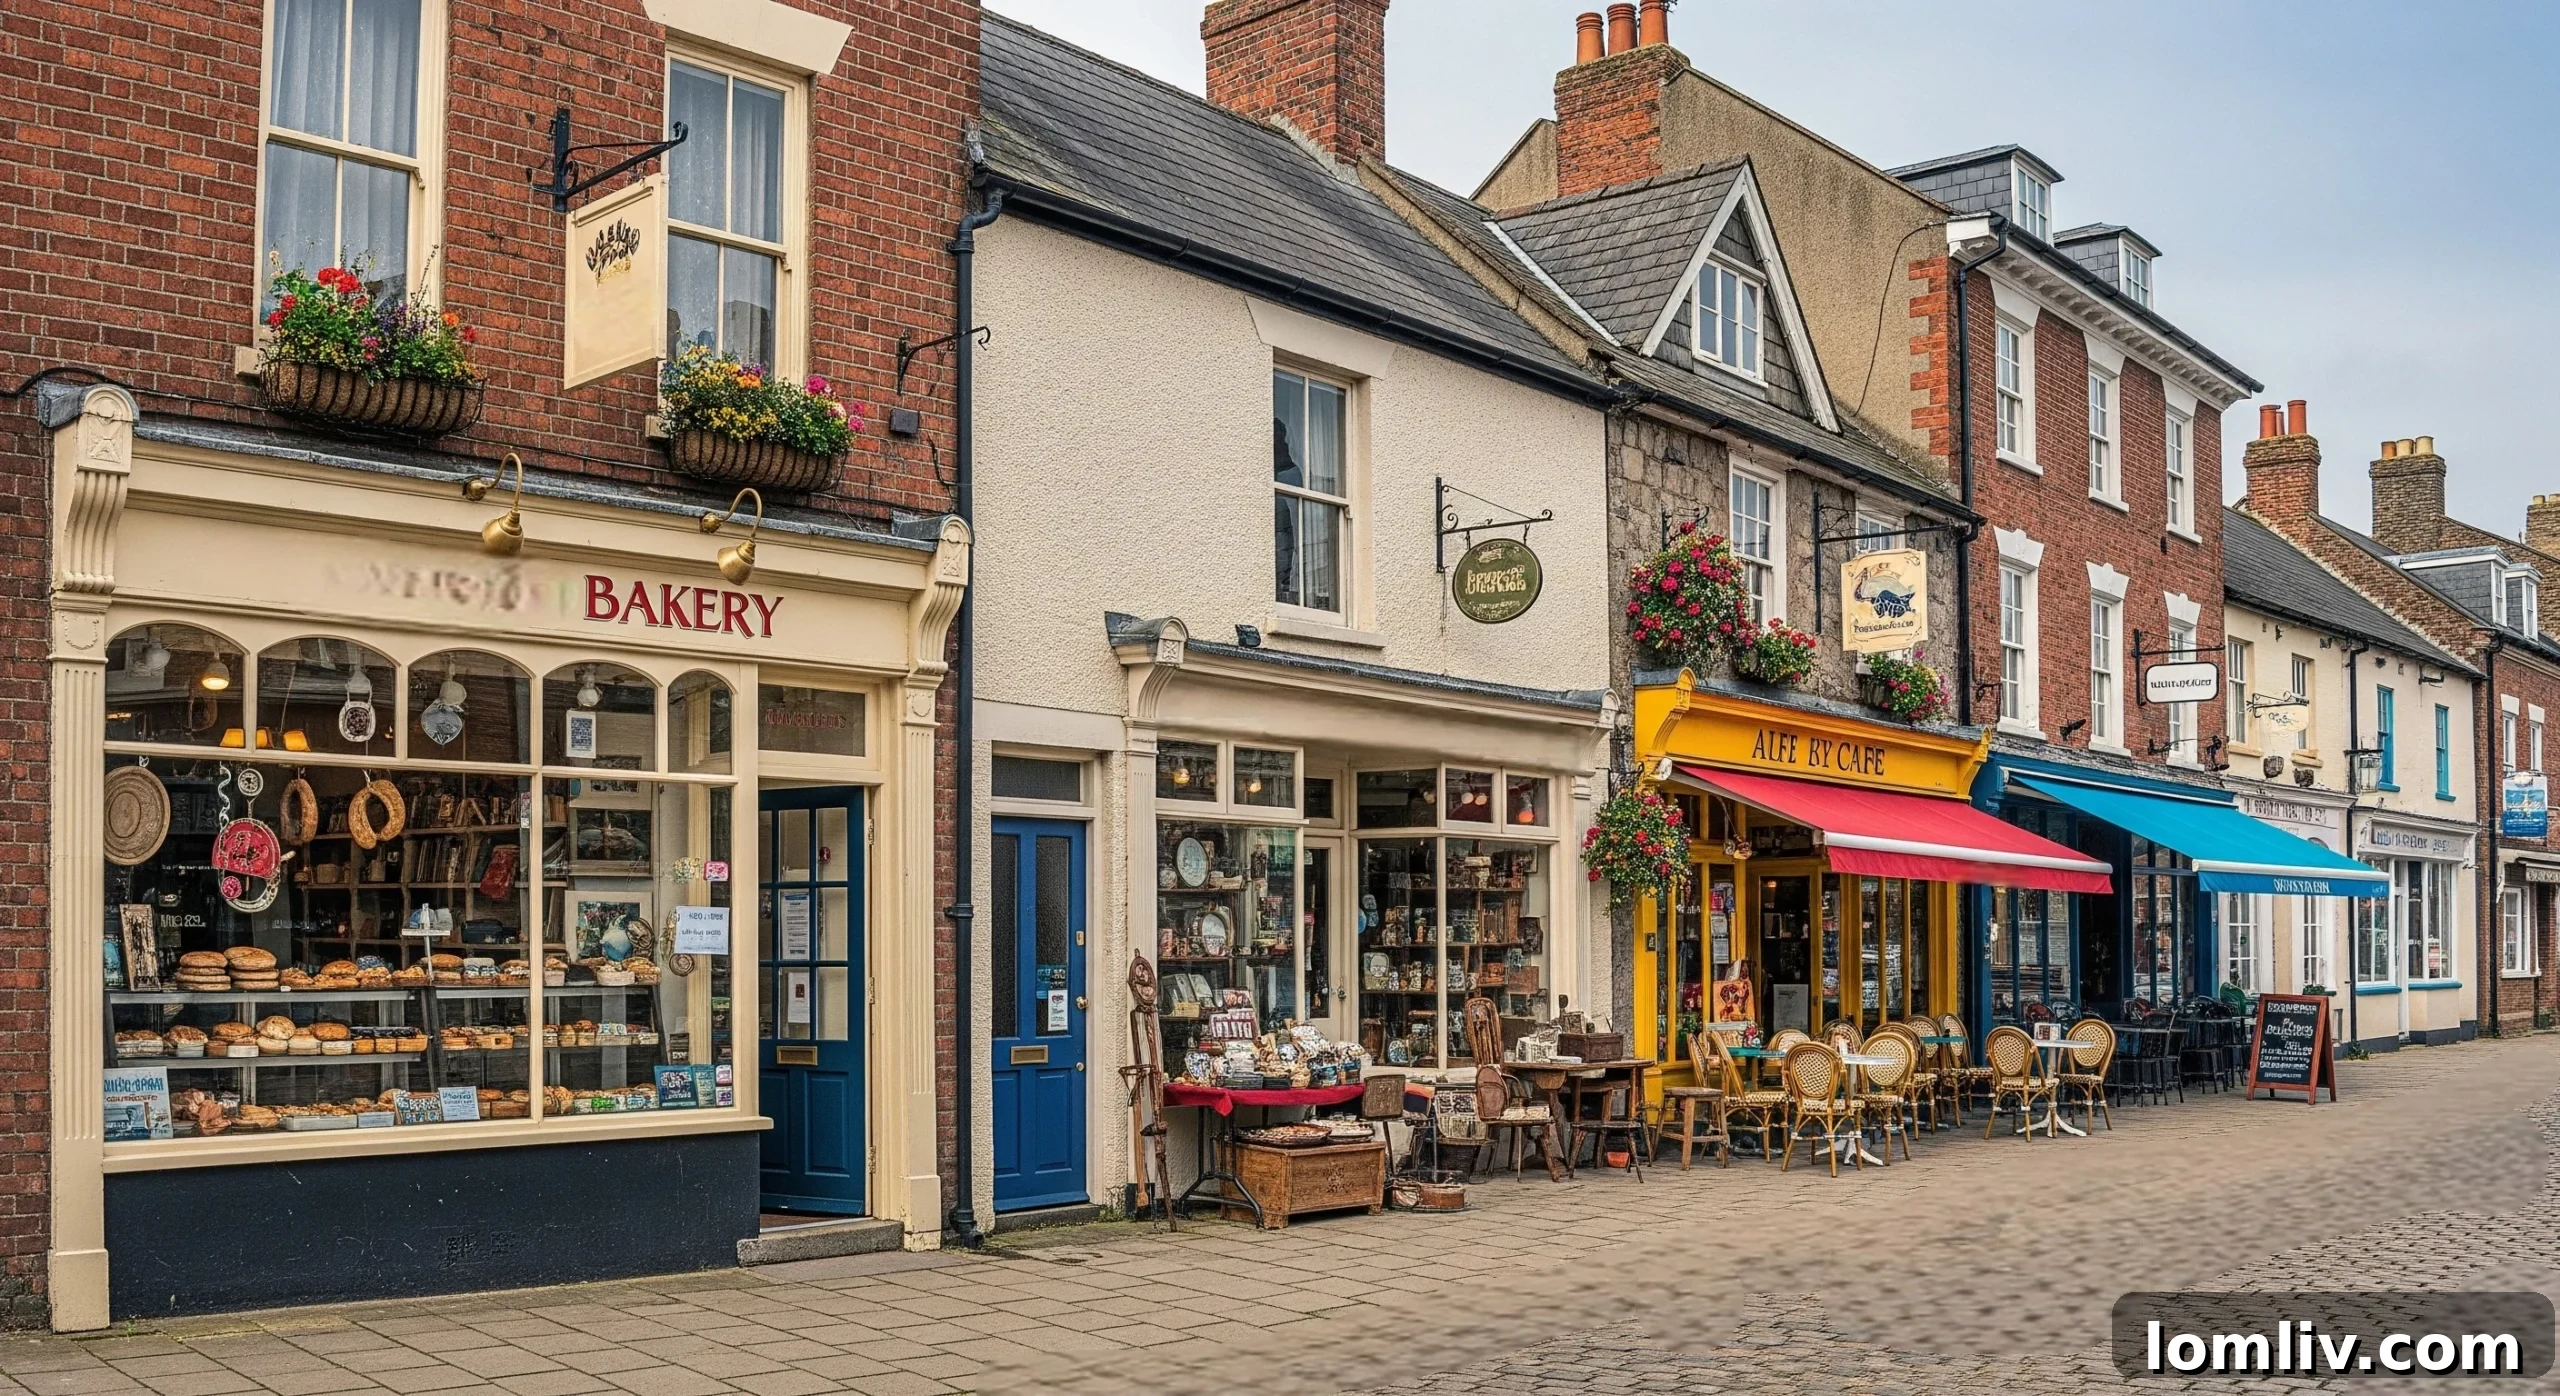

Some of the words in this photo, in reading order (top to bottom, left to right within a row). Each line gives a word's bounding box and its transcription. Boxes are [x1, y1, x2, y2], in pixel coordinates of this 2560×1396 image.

[583, 575, 785, 639] BAKERY
[1808, 737, 1833, 768] BY
[1837, 742, 1885, 776] CAFE
